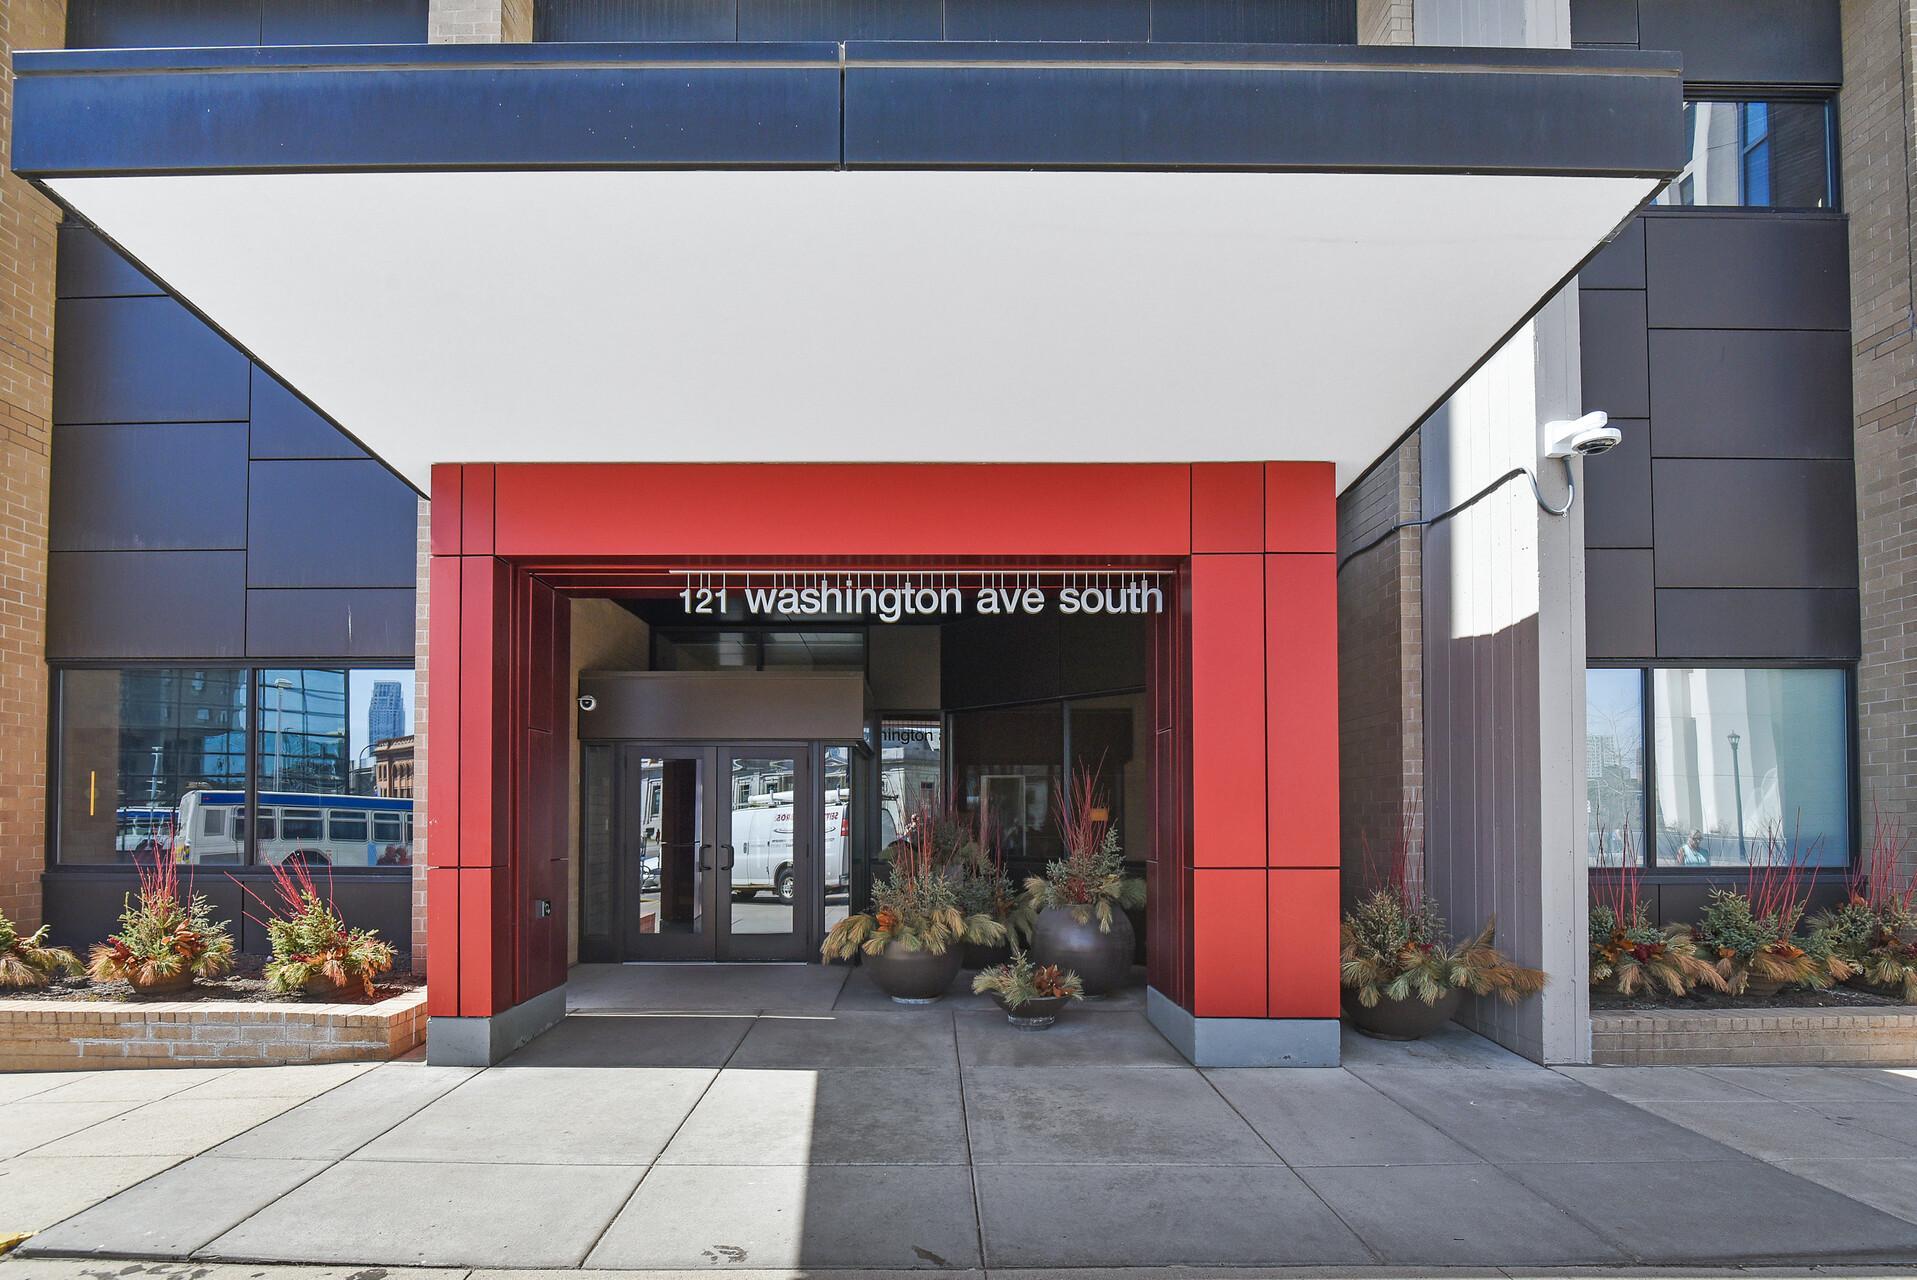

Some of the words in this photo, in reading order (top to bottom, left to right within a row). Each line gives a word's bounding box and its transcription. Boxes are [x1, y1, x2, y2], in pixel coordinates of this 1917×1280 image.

[679, 588, 727, 613] 121
[745, 580, 961, 623] washington
[976, 588, 1044, 614] ave
[1059, 580, 1163, 614] south
